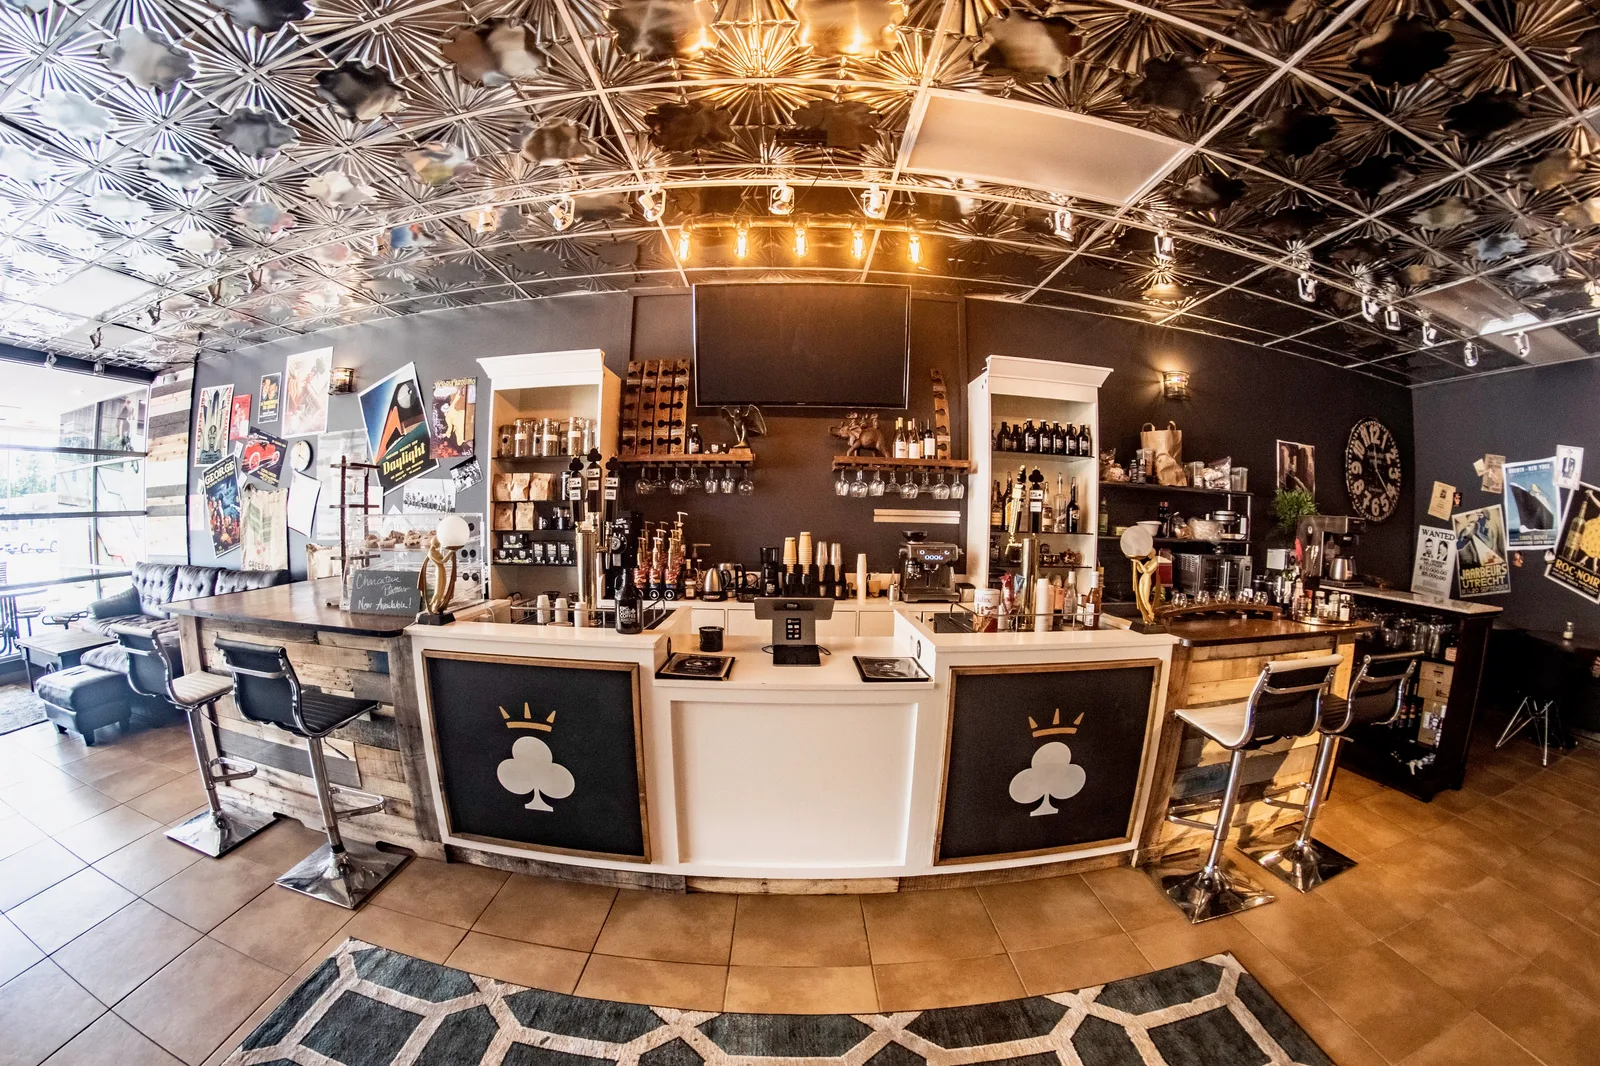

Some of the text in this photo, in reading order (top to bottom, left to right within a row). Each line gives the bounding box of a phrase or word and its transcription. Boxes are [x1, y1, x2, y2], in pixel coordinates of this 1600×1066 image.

[1369, 423, 1380, 444] 12
[1381, 431, 1389, 449] 1
[383, 442, 425, 476] Daylight
[1352, 440, 1366, 460] 10
[1385, 448, 1398, 465] 2
[204, 460, 235, 485] GEORGE
[1350, 461, 1363, 475] 9
[1388, 467, 1400, 480] 3
[1353, 479, 1365, 495] 8
[1386, 482, 1397, 499] 4
[1362, 490, 1373, 509] 7
[1371, 497, 1380, 517] 6
[1380, 493, 1389, 512] 5
[1421, 528, 1456, 541] WANTED
[1460, 563, 1508, 580] JAARBEURS
[1555, 558, 1600, 588] ROC-NOIR
[1462, 575, 1506, 589] UTRECHT
